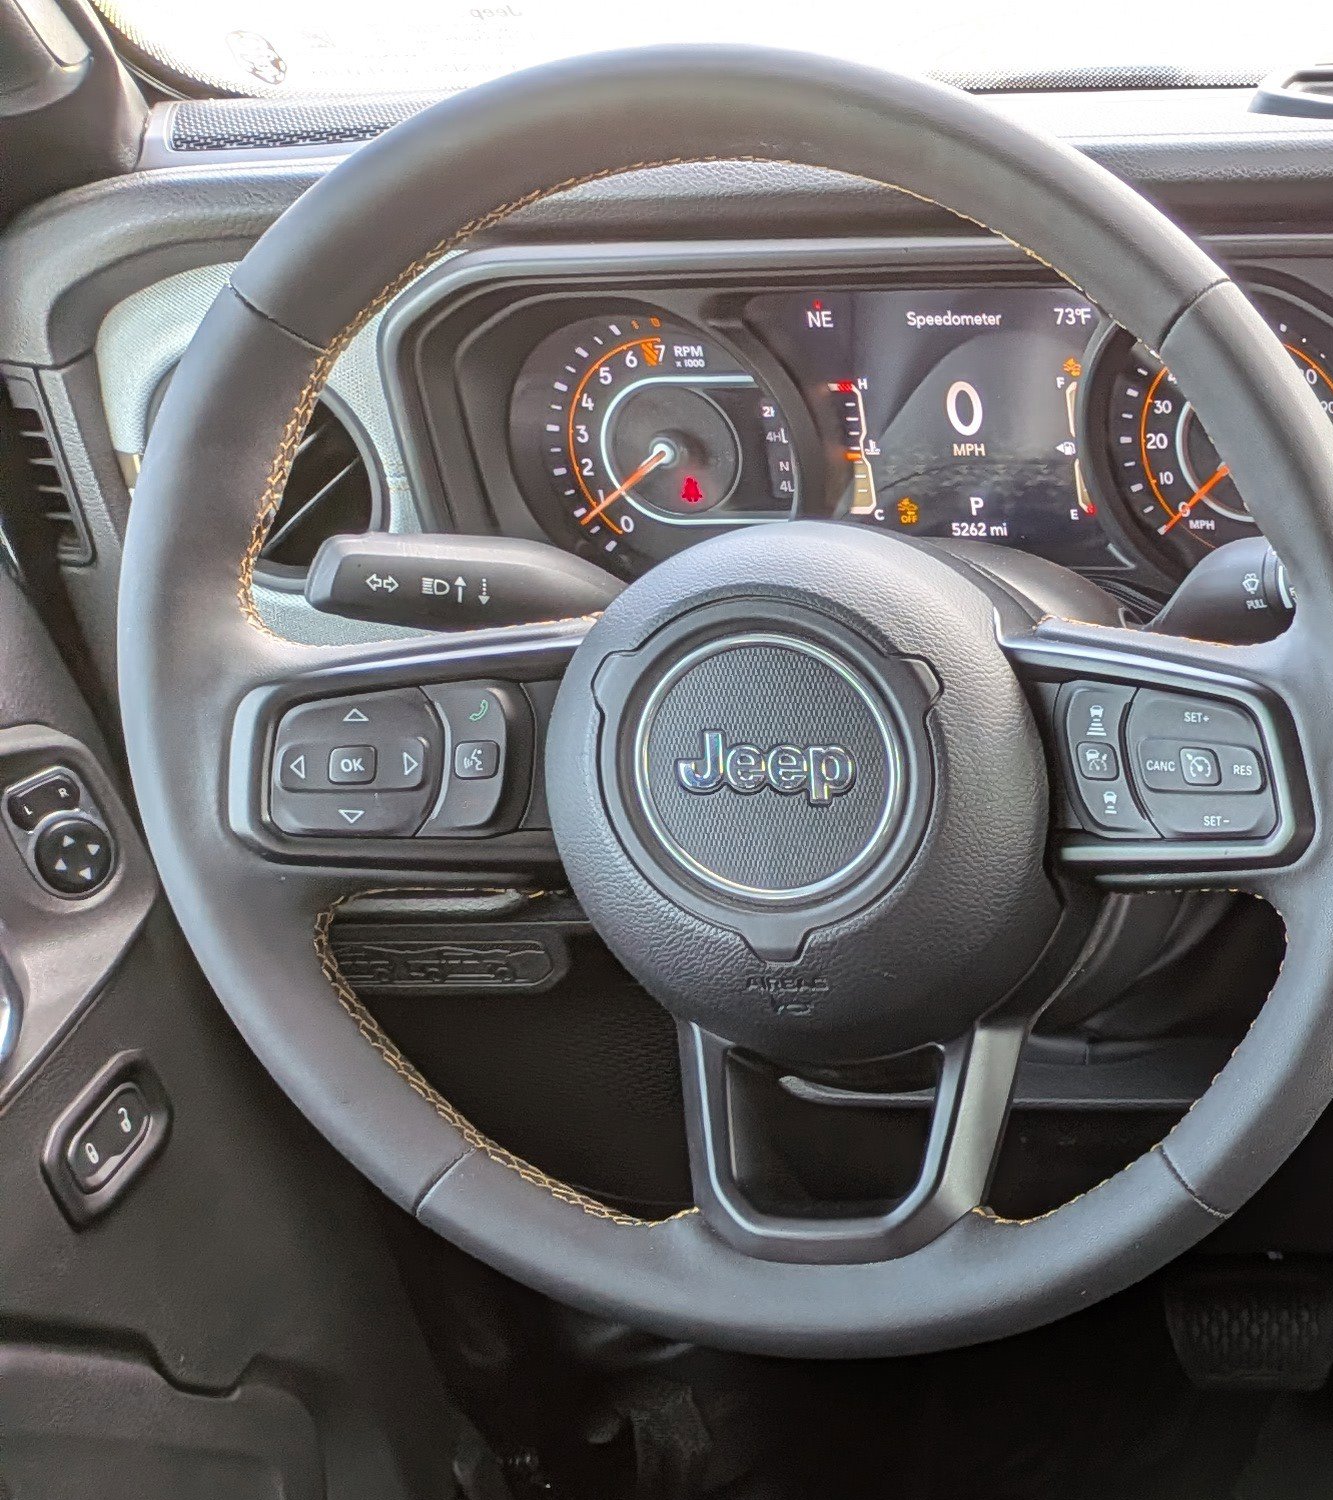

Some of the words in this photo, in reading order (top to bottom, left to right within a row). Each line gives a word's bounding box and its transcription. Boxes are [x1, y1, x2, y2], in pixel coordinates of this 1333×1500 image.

[806, 310, 834, 328] NE
[906, 311, 1002, 329] Speedometer
[625, 350, 638, 368] 6
[673, 345, 704, 357] RPM
[684, 358, 705, 368] 1000
[600, 366, 613, 385] 5
[857, 377, 868, 390] H
[1056, 378, 1065, 389] F
[581, 393, 594, 411] 4
[946, 380, 983, 436] 0
[1153, 399, 1173, 415] 30
[575, 425, 589, 443] 3
[1146, 433, 1168, 450] 20
[952, 444, 986, 458] MPH
[581, 458, 595, 477] 2
[779, 461, 790, 472] N
[1159, 471, 1174, 485] 10
[971, 497, 984, 516] P
[1070, 509, 1079, 520] E
[874, 509, 885, 521] C
[900, 515, 918, 524] OFF
[620, 516, 634, 533] 0
[952, 522, 987, 538] 5262
[989, 522, 1008, 538] mi
[1189, 519, 1215, 531] MPH
[340, 757, 365, 773] OK
[676, 730, 857, 807] Jeep
[1146, 759, 1176, 774] CANC
[1233, 764, 1253, 777] RES
[58, 787, 70, 798] R
